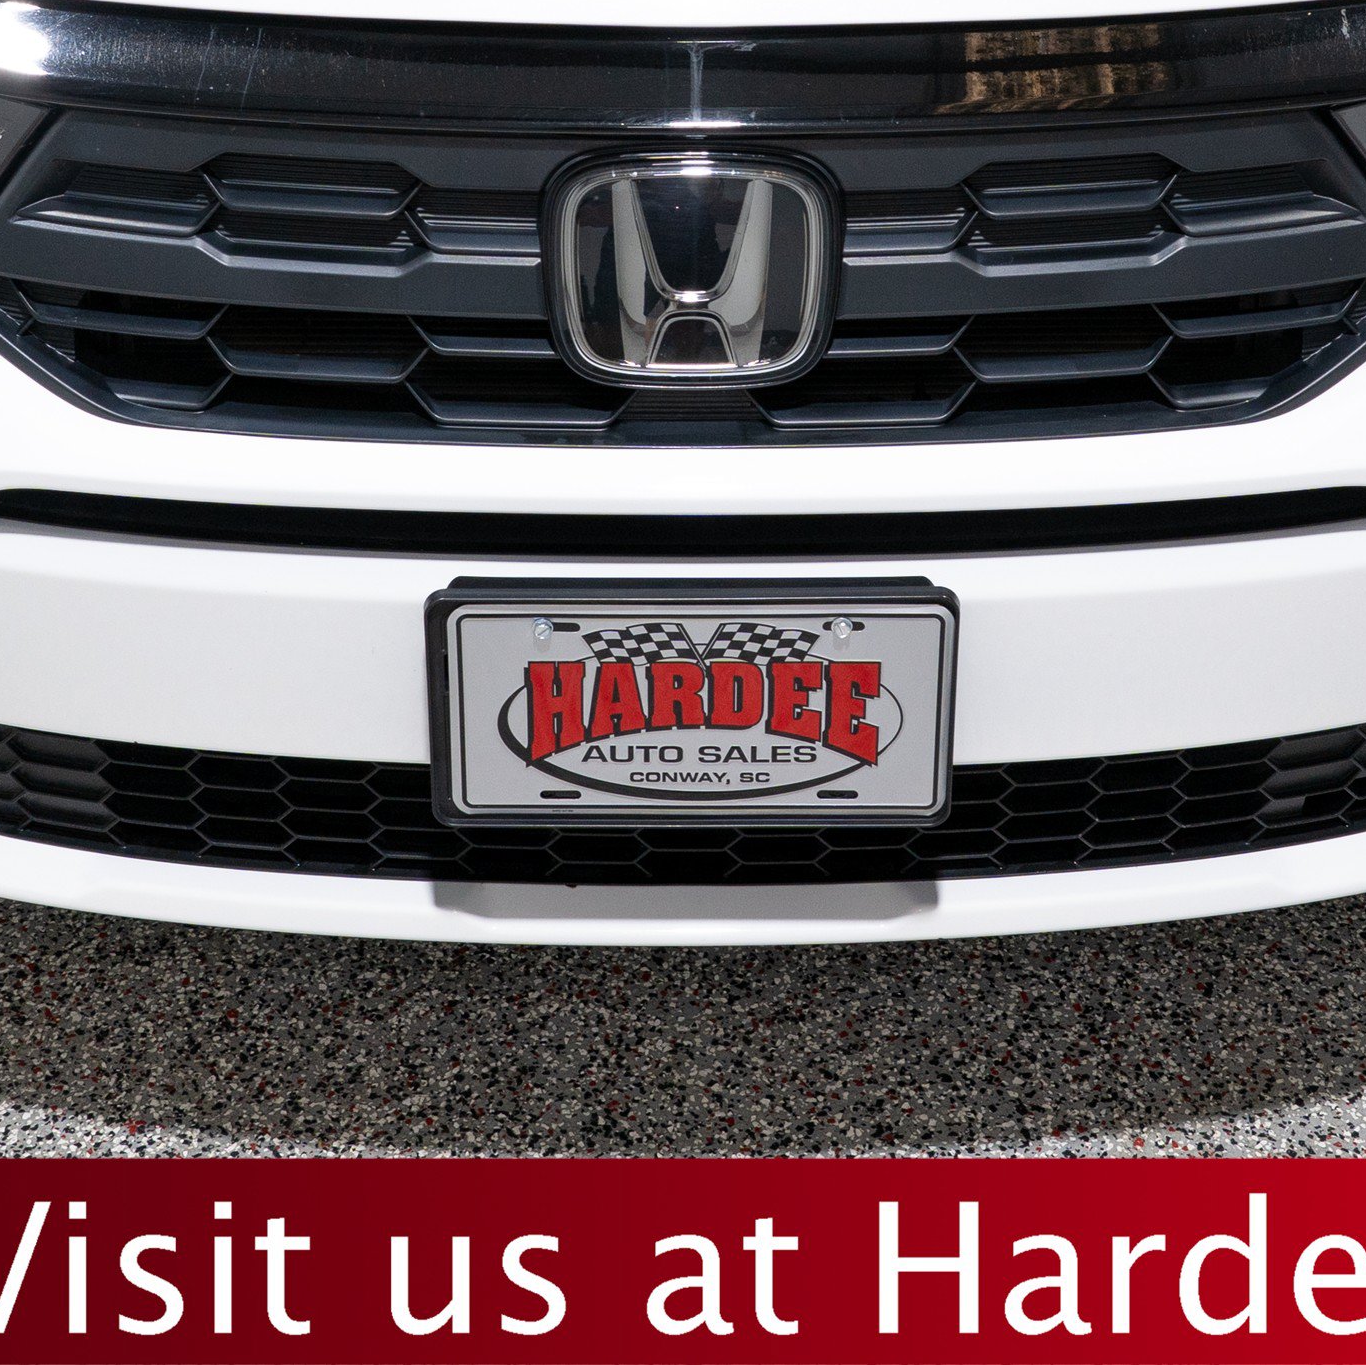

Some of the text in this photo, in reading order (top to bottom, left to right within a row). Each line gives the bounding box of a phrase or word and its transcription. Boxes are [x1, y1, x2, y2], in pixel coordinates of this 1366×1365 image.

[524, 661, 882, 767] HARDEE
[581, 745, 818, 764] AUTO SALES
[629, 772, 771, 785] CONWAY, SC
